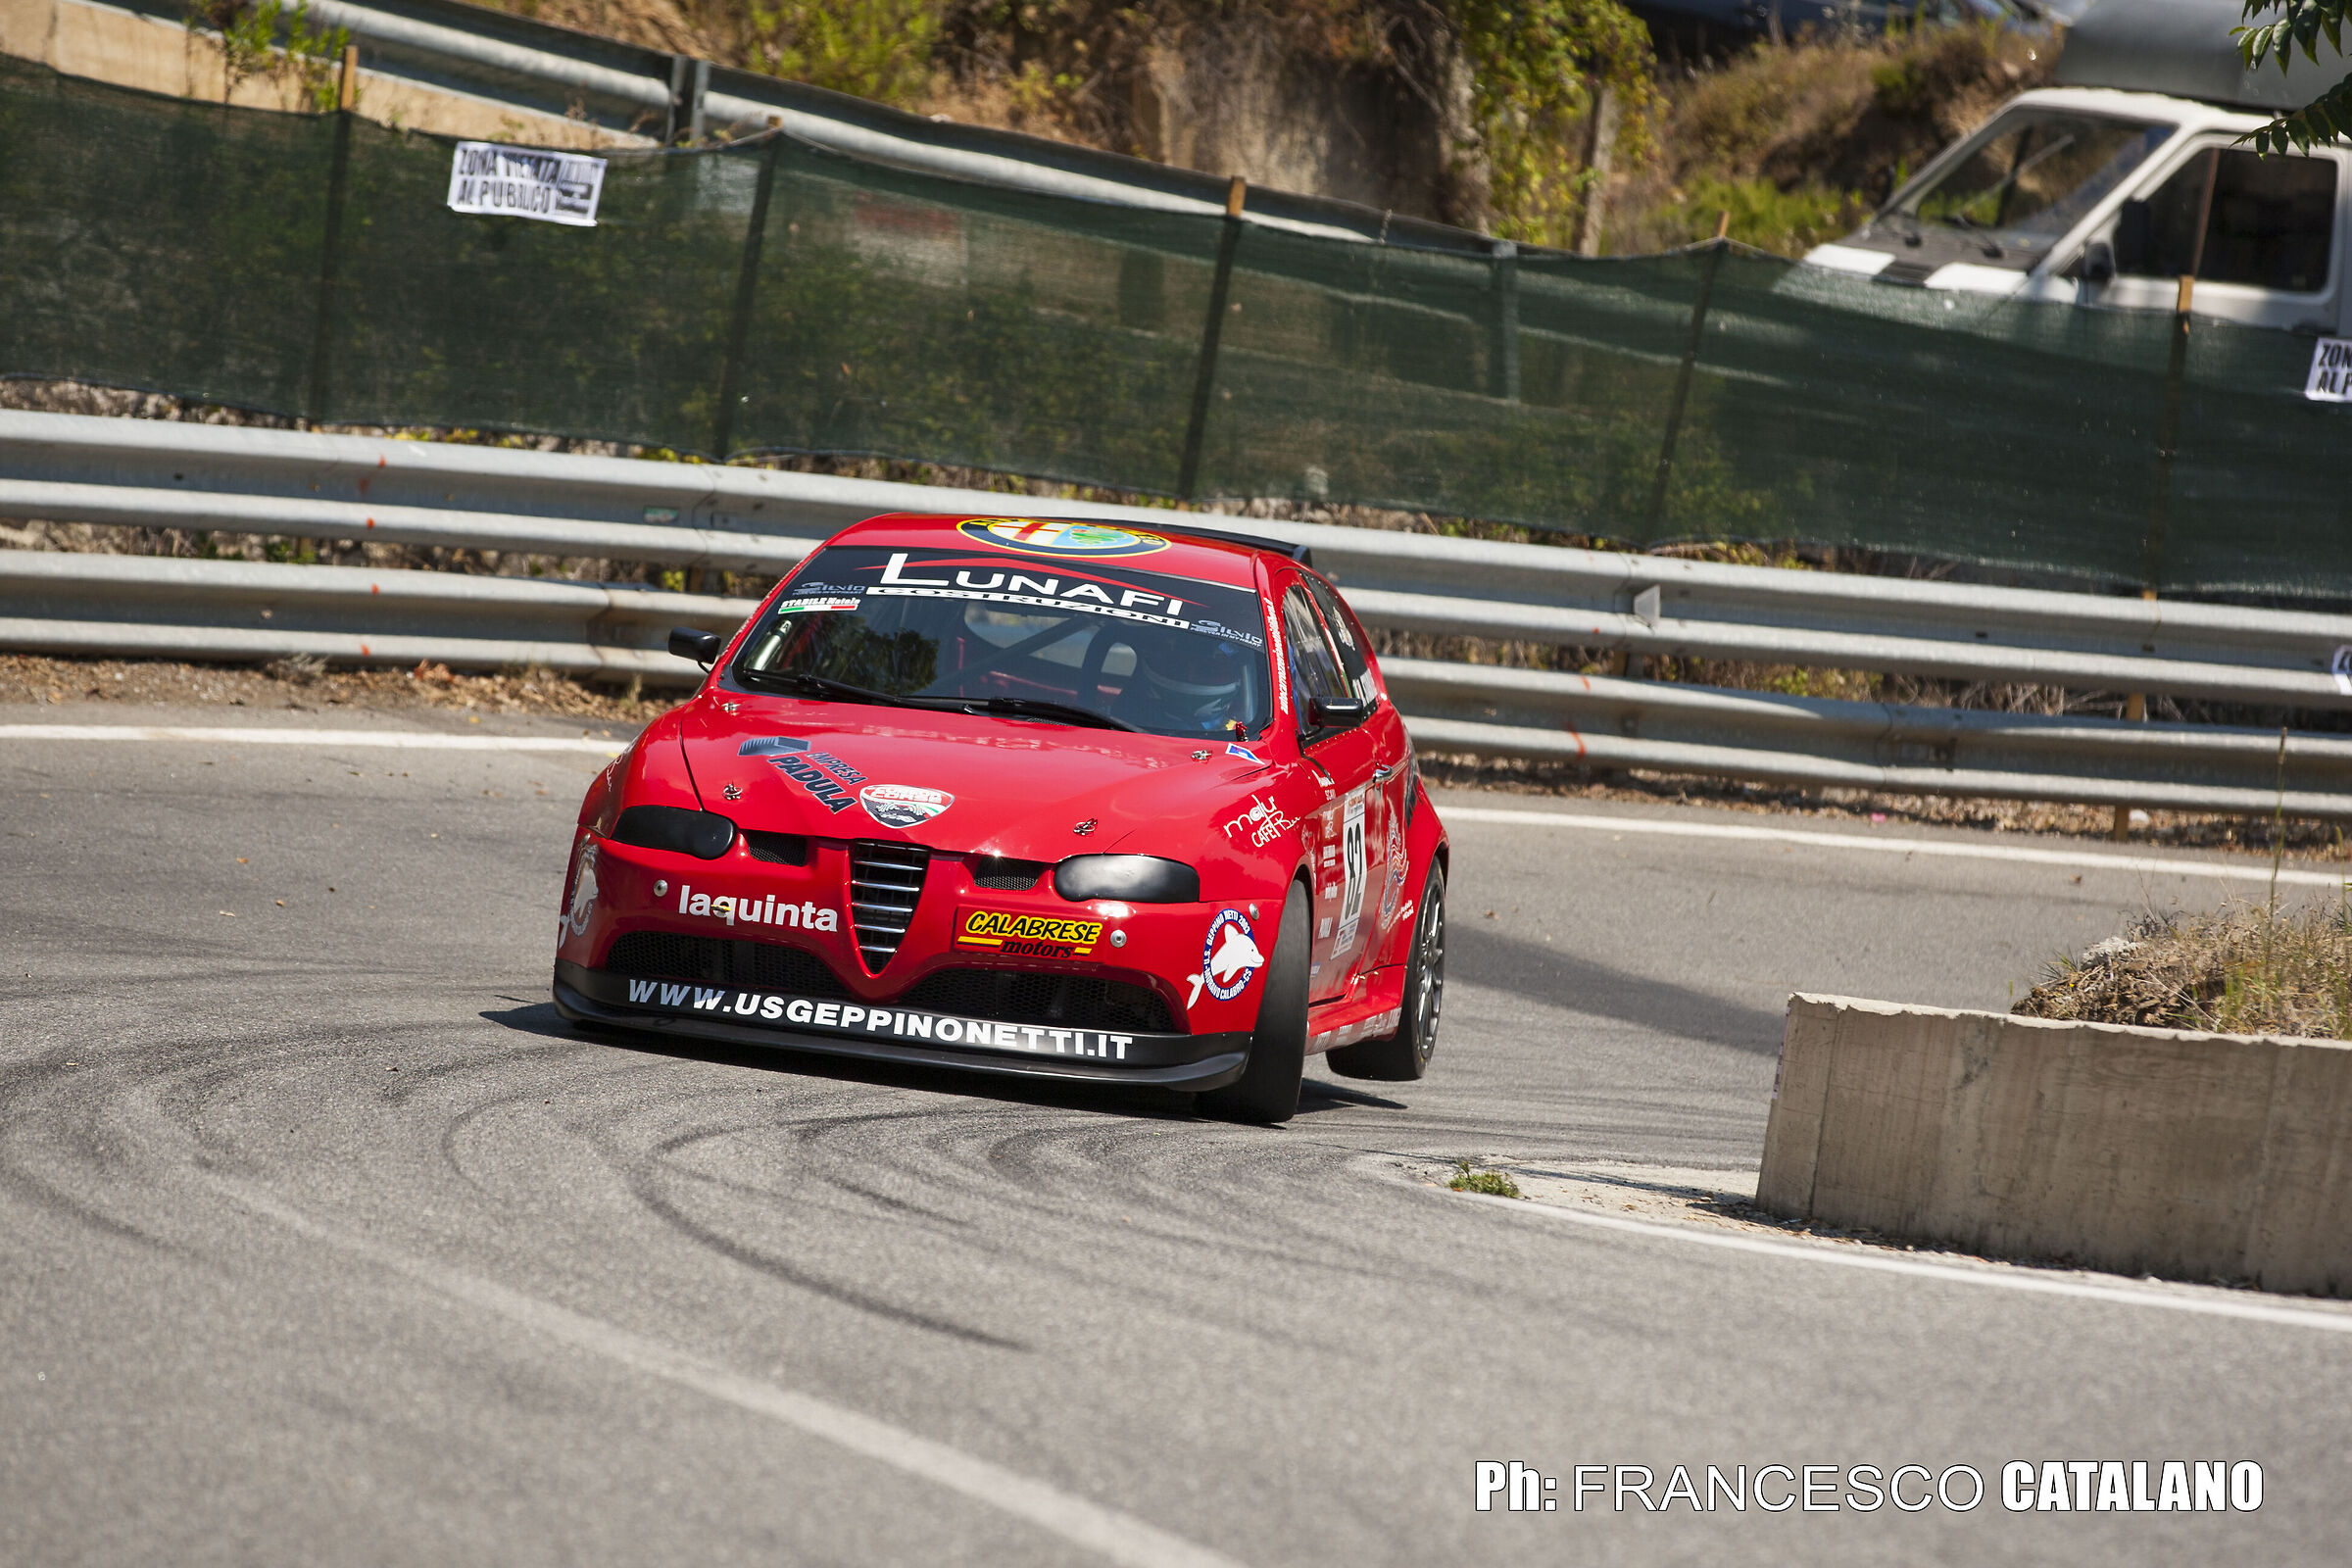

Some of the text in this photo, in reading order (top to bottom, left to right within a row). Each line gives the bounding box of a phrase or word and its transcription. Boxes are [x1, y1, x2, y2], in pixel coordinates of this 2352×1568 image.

[458, 178, 476, 205] AL
[880, 553, 1183, 616] LUNAFI
[880, 588, 1183, 627] COSTRUZIONI
[767, 756, 858, 814] PADULA
[807, 752, 868, 785] IMPRESA
[1345, 822, 1363, 920] 82
[678, 885, 839, 932] laquinta
[965, 910, 1103, 945] CALABRESE
[1000, 940, 1075, 959] motors
[627, 979, 1133, 1059] WWW.USGEPPINONETTI.IT
